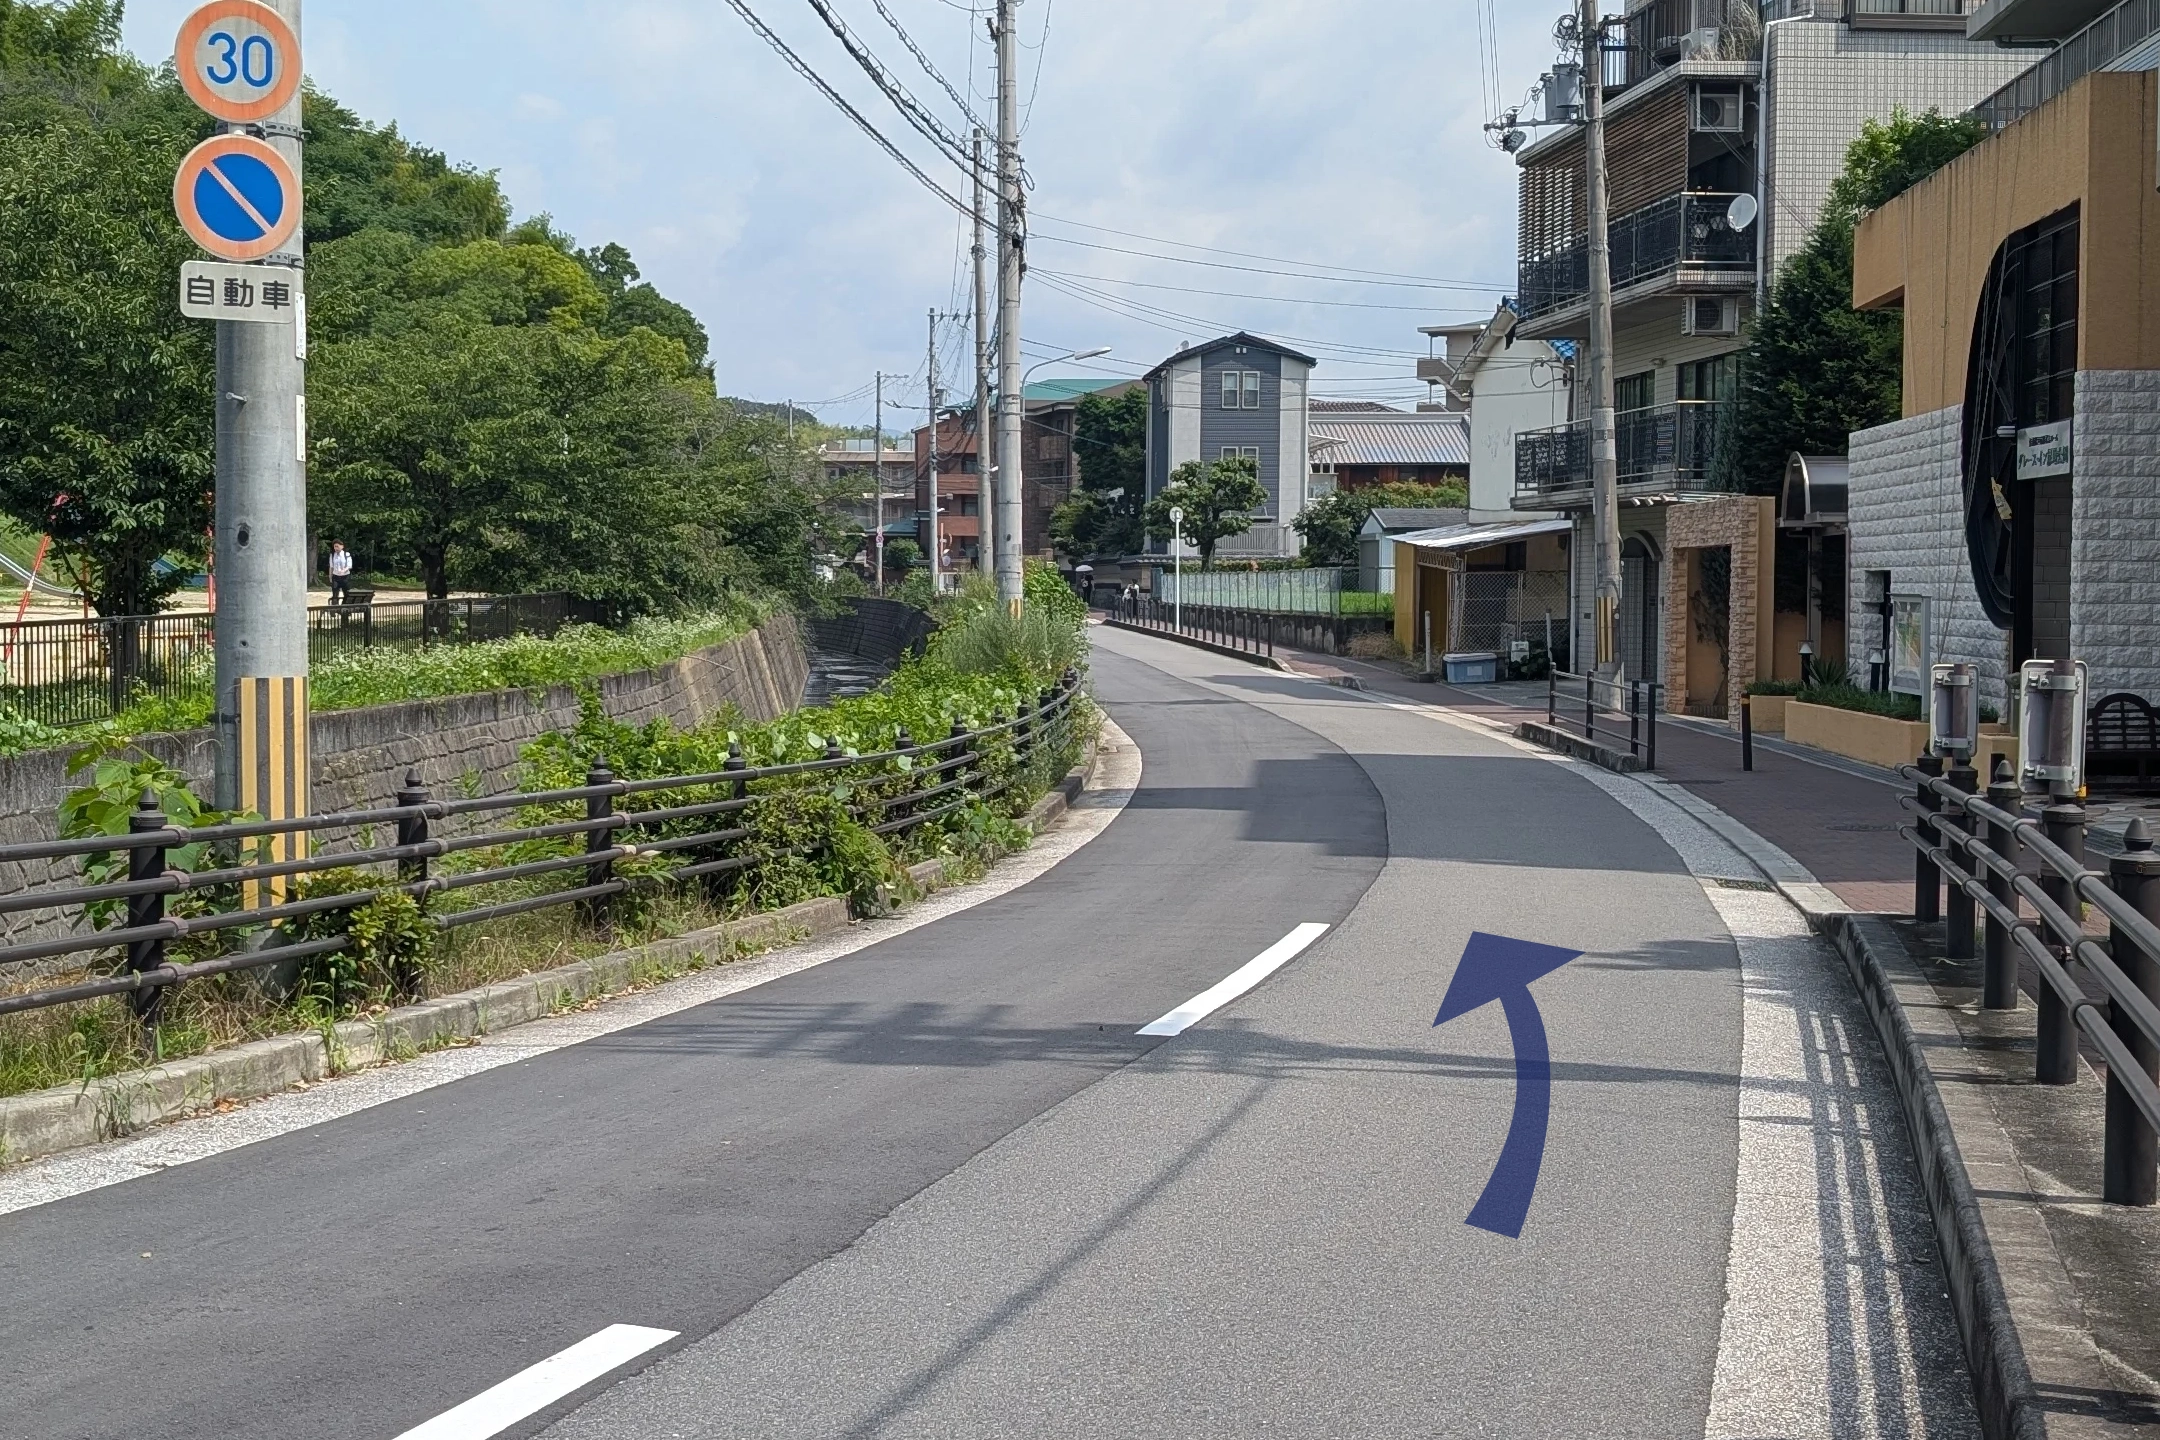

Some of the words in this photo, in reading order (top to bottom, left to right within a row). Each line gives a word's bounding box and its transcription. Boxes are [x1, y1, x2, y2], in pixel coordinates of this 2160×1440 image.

[207, 32, 273, 87] 30
[187, 275, 290, 310] 自動車
